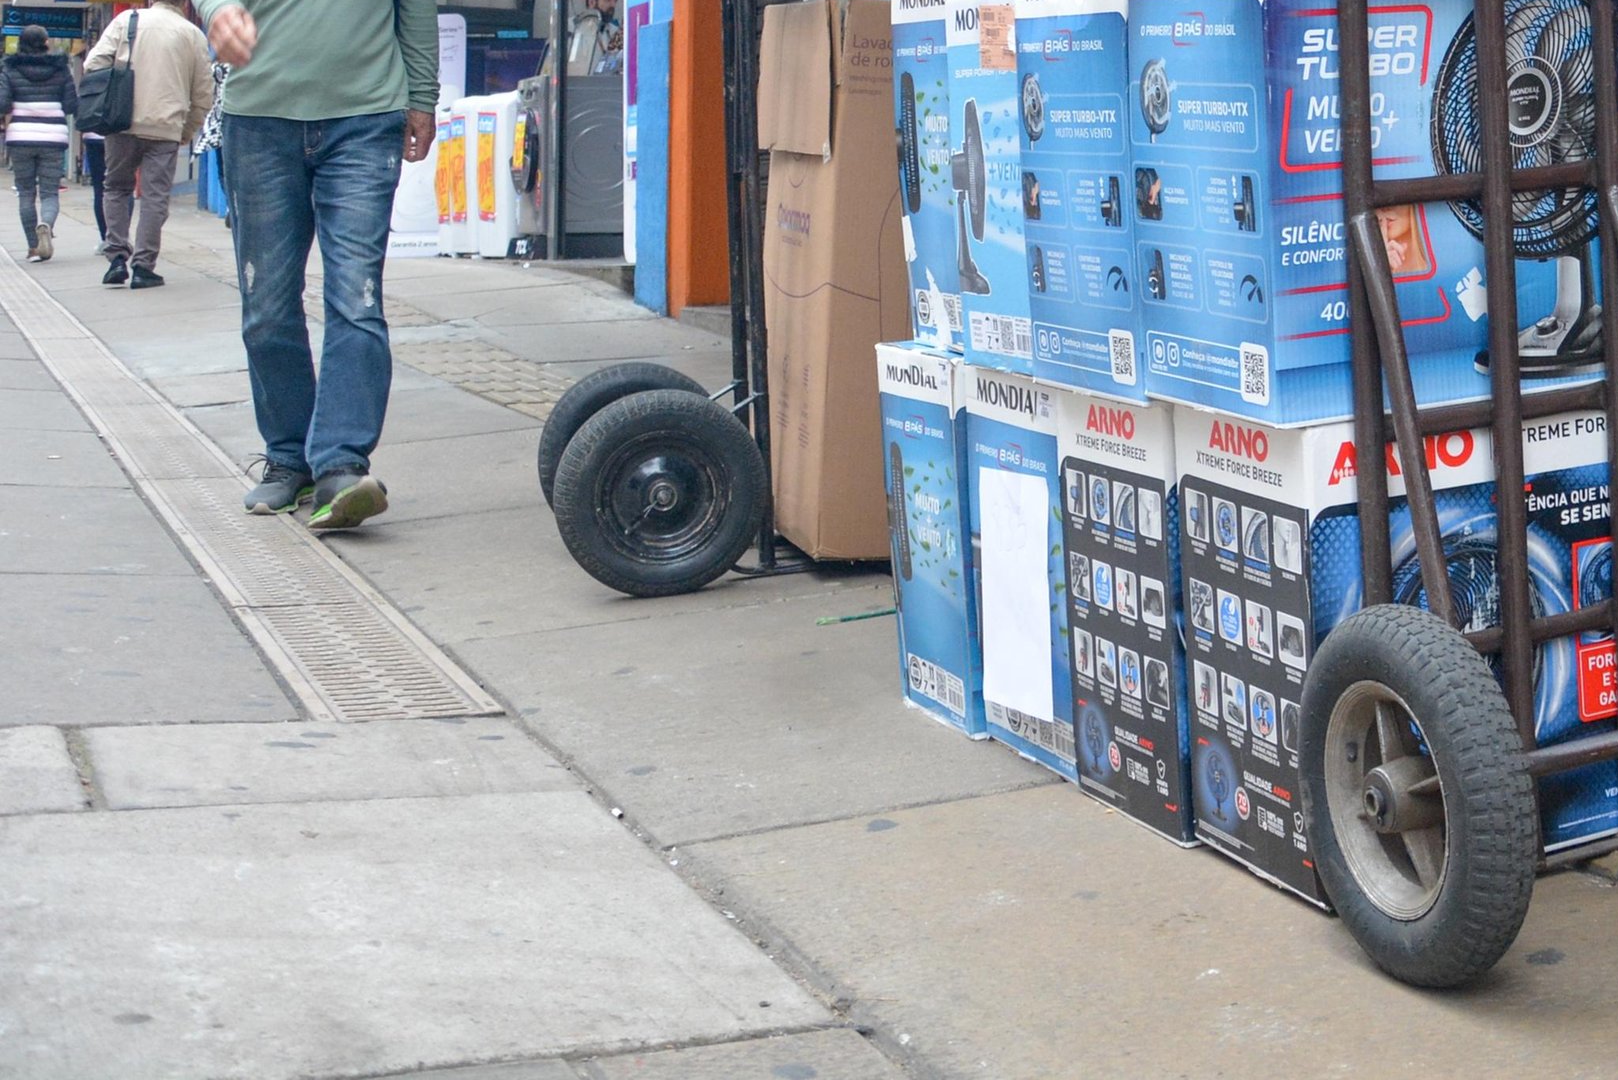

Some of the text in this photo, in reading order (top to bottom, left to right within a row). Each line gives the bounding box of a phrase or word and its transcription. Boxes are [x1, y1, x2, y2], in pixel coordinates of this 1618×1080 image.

[1174, 22, 1183, 37] 8
[1302, 25, 1417, 53] SUER
[850, 52, 870, 67] de
[1297, 52, 1415, 81] TUBO
[1177, 99, 1249, 117] SUPER TURBO-VTX
[1307, 92, 1385, 120] MUO
[1050, 109, 1116, 124] SUPER TURBO-VTX
[1074, 127, 1089, 138] MAIS
[1090, 127, 1113, 139] VENTO
[1205, 120, 1222, 133] MAIS
[1222, 121, 1245, 134] VENTO
[1281, 220, 1345, 246] SILÊNC
[1281, 251, 1290, 266] E
[1086, 403, 1135, 441] ARNO
[1575, 416, 1606, 436] FOR
[1075, 433, 1147, 463] XTREME FORCE BREEZE
[1209, 419, 1269, 463] ARNO
[1196, 450, 1283, 488] XTREME FORCE BREEZE
[1570, 486, 1597, 506] QUE
[1560, 507, 1580, 526] SE
[1602, 672, 1611, 687] E
